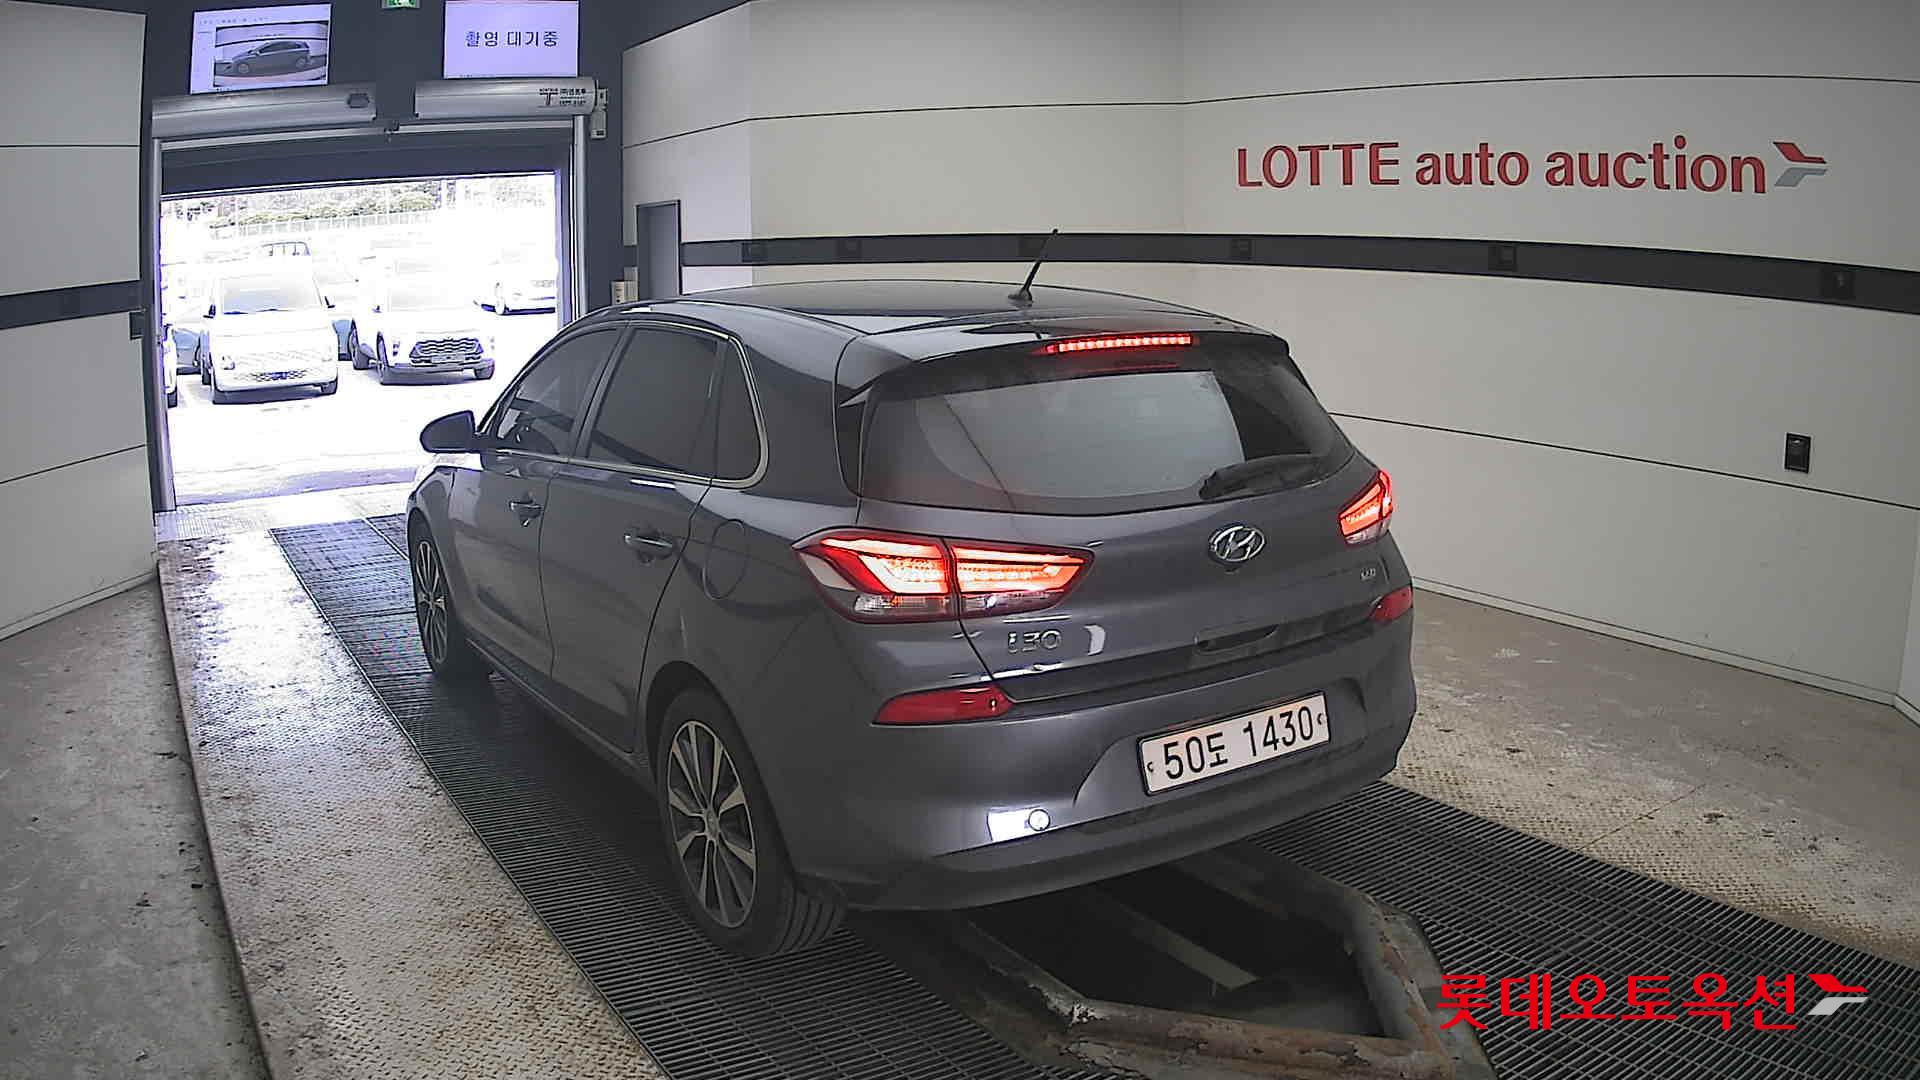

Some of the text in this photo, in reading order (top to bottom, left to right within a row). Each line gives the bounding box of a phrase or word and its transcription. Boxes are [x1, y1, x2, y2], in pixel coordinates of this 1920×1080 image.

[1238, 134, 1766, 194] LOTTE auto auction
[1163, 705, 1314, 780] 50도 1430
